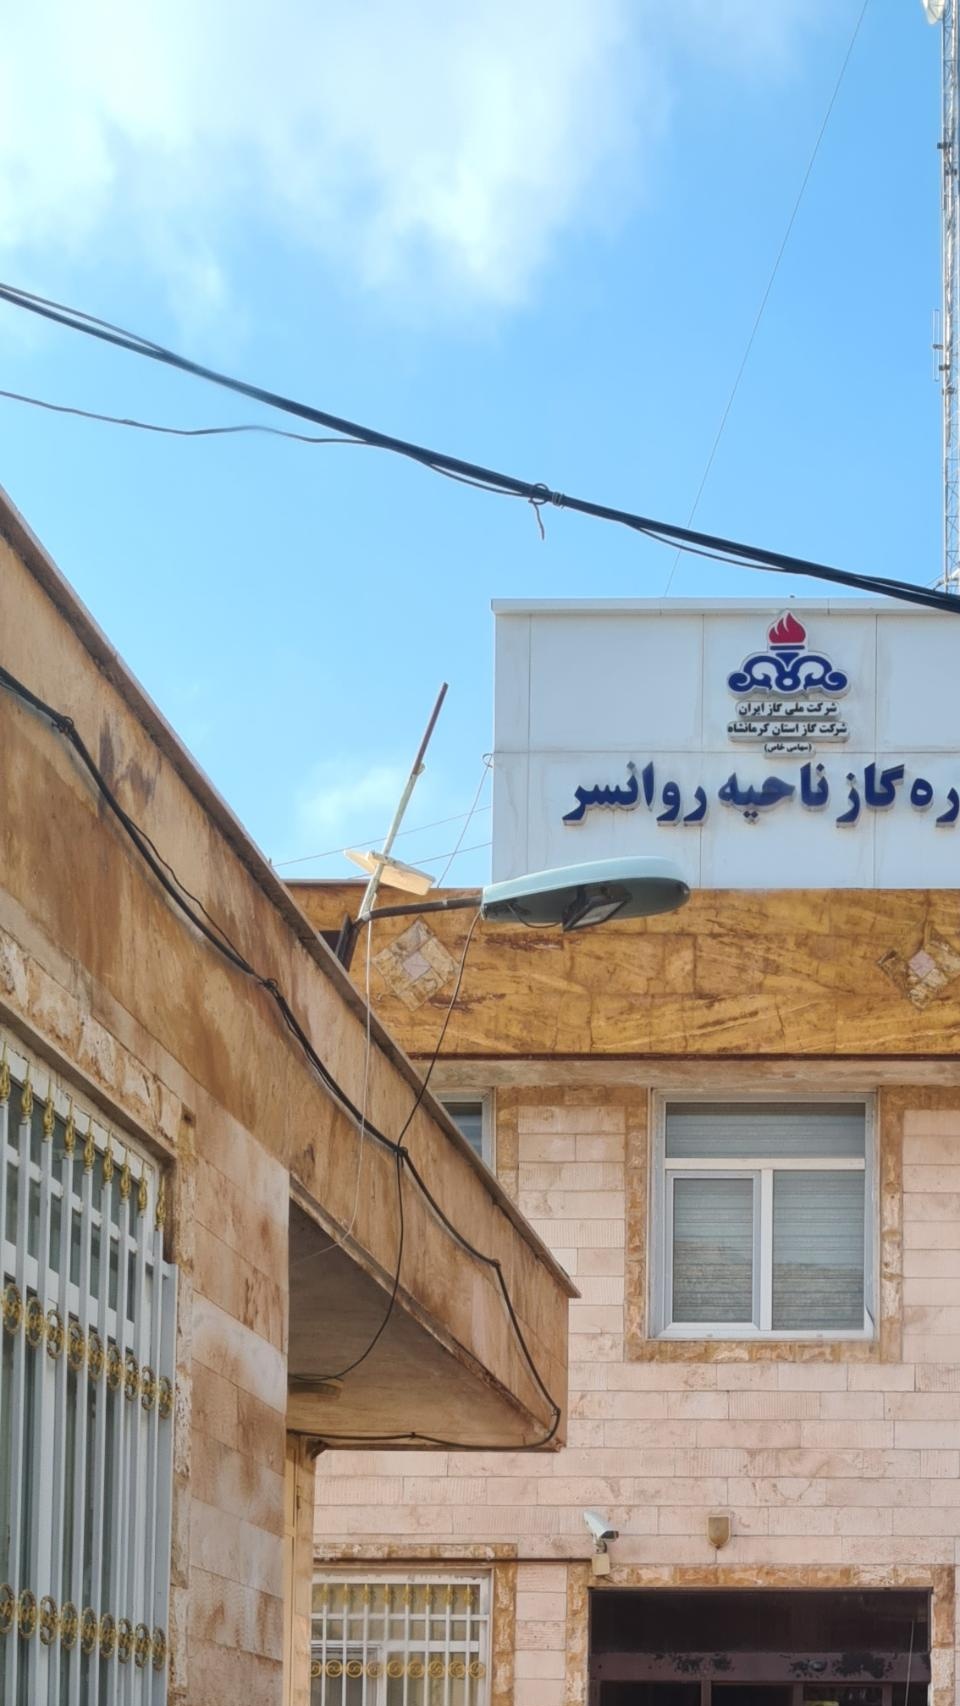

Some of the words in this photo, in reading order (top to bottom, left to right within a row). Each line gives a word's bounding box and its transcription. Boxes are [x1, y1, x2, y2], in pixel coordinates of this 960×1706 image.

[738, 702, 765, 716] ایران
[767, 702, 783, 716] گاز
[784, 702, 804, 716] ملی
[806, 702, 837, 716] شرکت
[727, 722, 770, 737] کرمانشاه
[771, 722, 799, 736] استان
[801, 723, 817, 737] گاز
[819, 722, 848, 737] شرکت
[561, 760, 708, 824] روانسر
[718, 761, 830, 821] ناحیه
[835, 761, 905, 825] گاز
